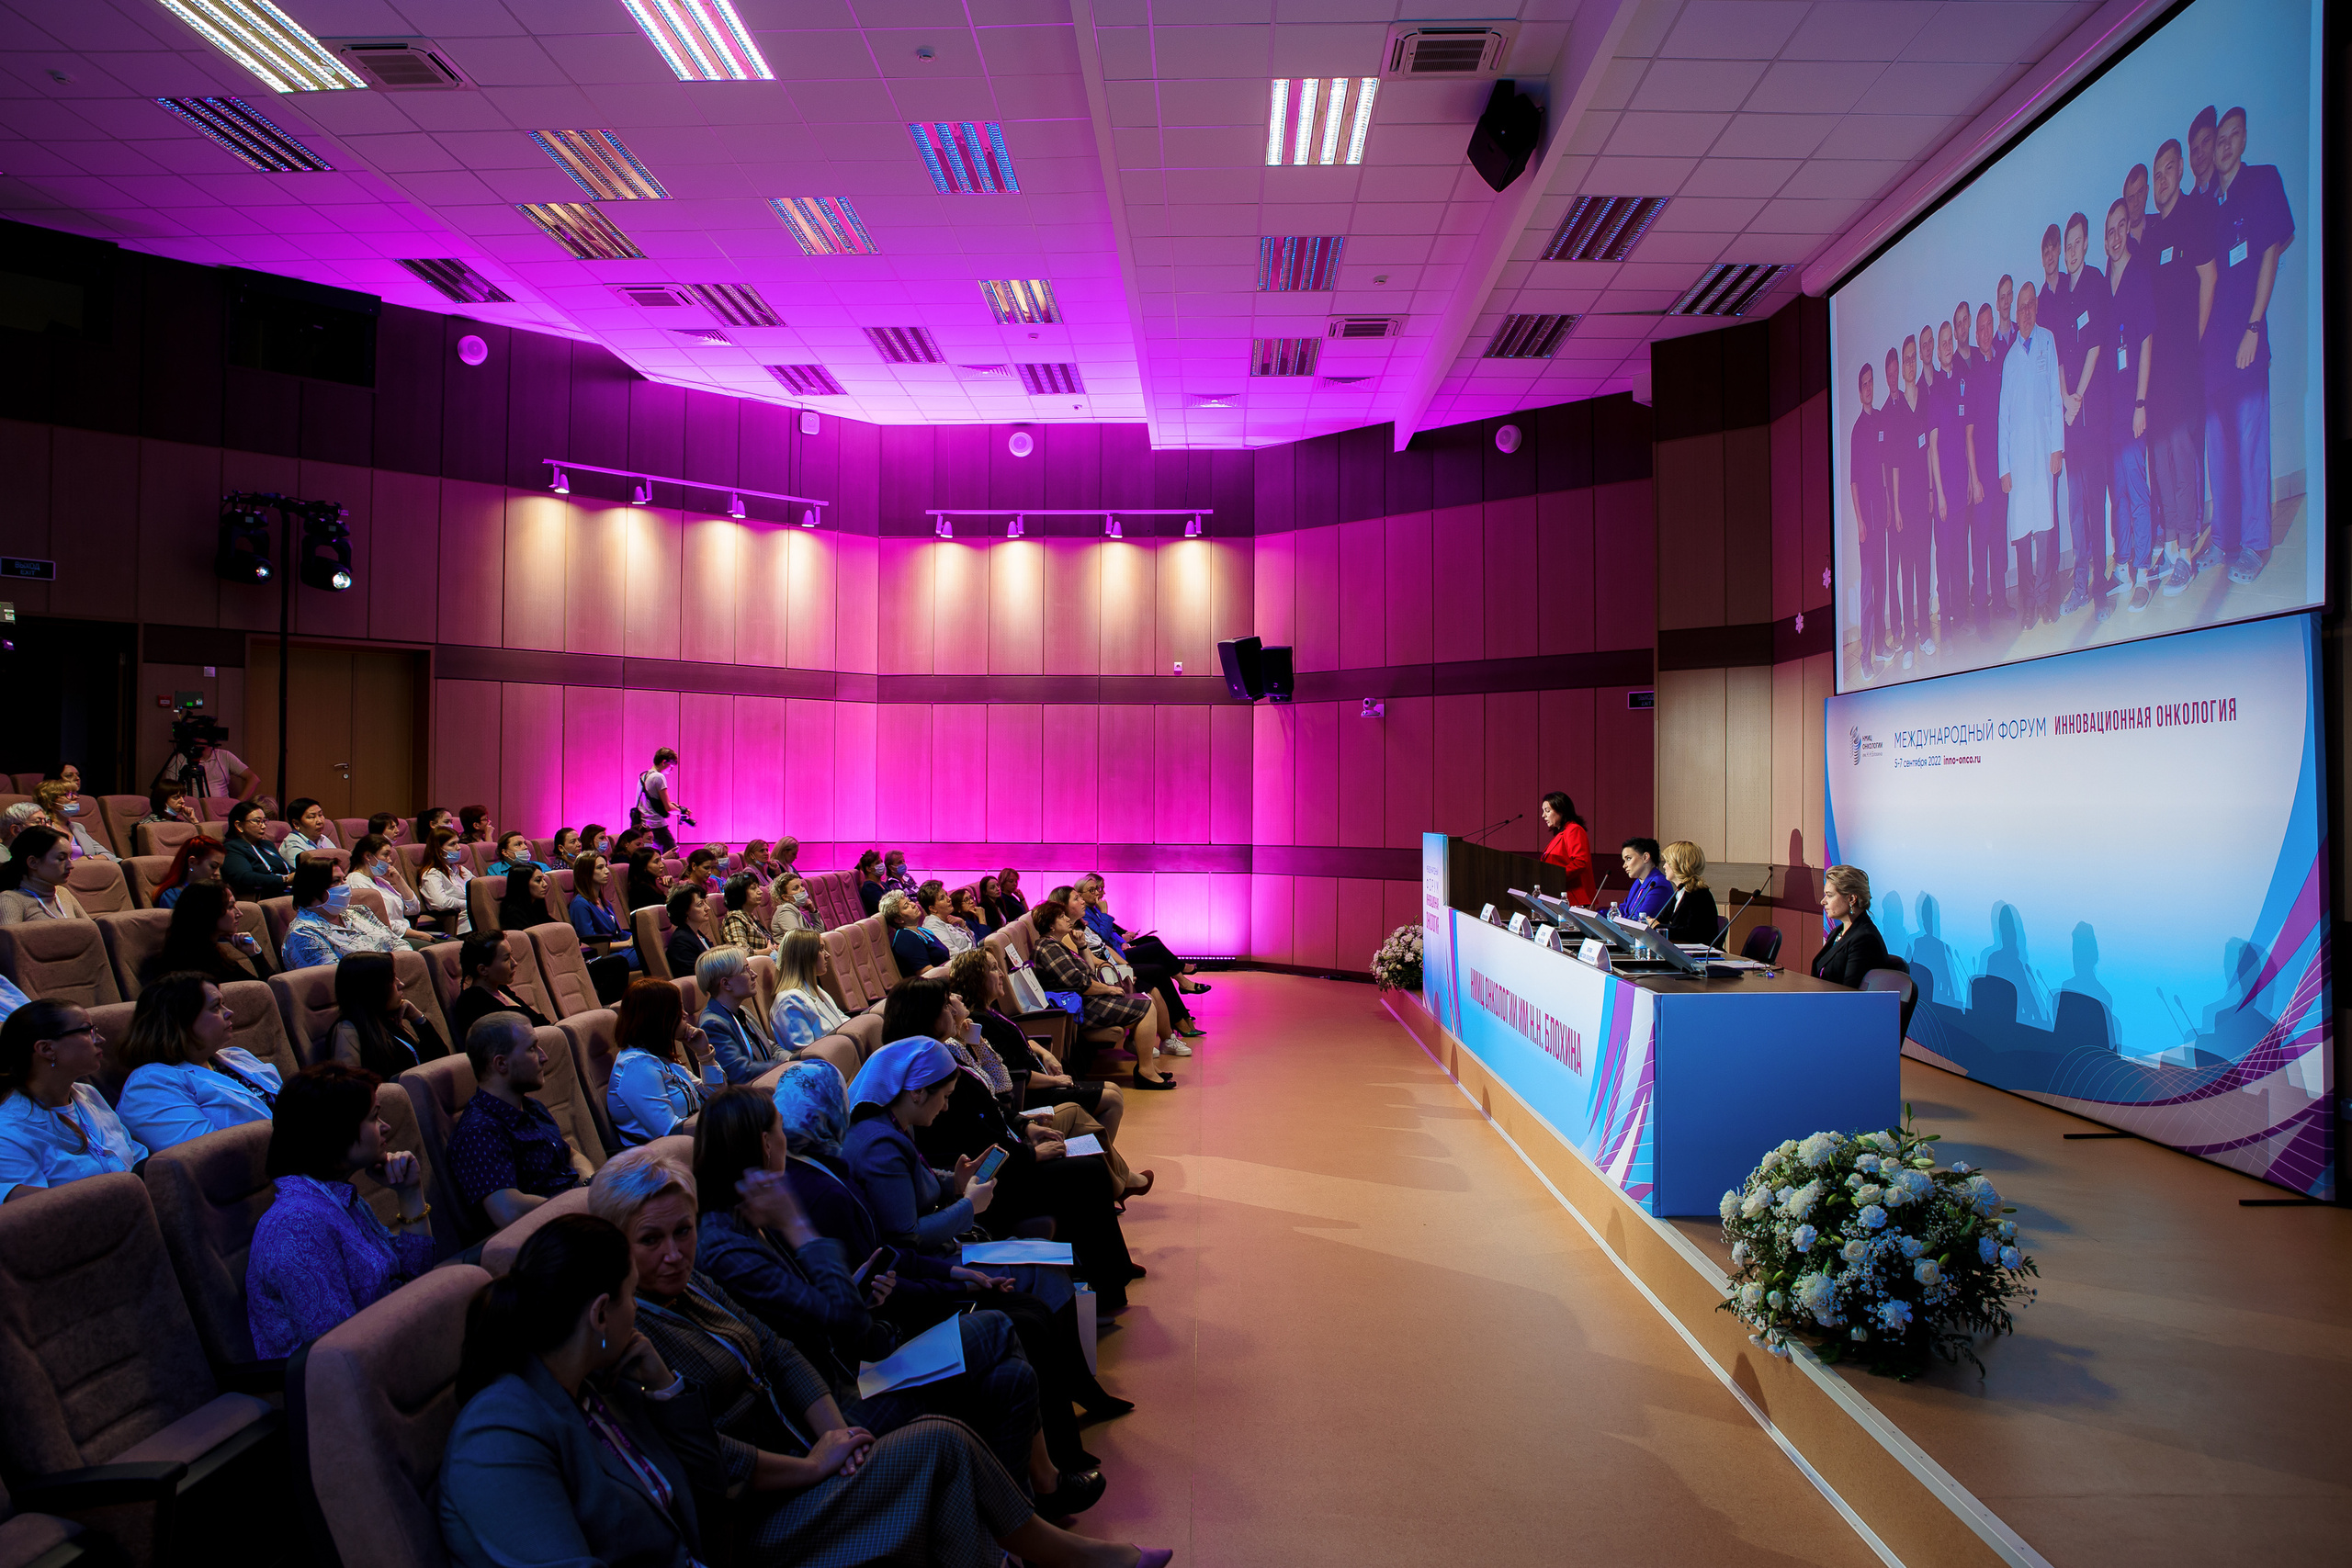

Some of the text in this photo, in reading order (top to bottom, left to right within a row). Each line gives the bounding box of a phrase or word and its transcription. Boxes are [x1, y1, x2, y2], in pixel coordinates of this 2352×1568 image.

[1894, 697, 2237, 750] МЕЖДУНАРОДНЫЙ ФОРУМ ИННОВАЦИОННАЯ ОНКОЛОГИЯ
[1894, 754, 1982, 770] 5-7 сентября 2022 inno-onco.ru
[1485, 976, 1518, 1031] ОНКОЛОГИИ
[1530, 1003, 1544, 1049] Н.Н.
[1544, 1012, 1582, 1077] БЛОХИНА
